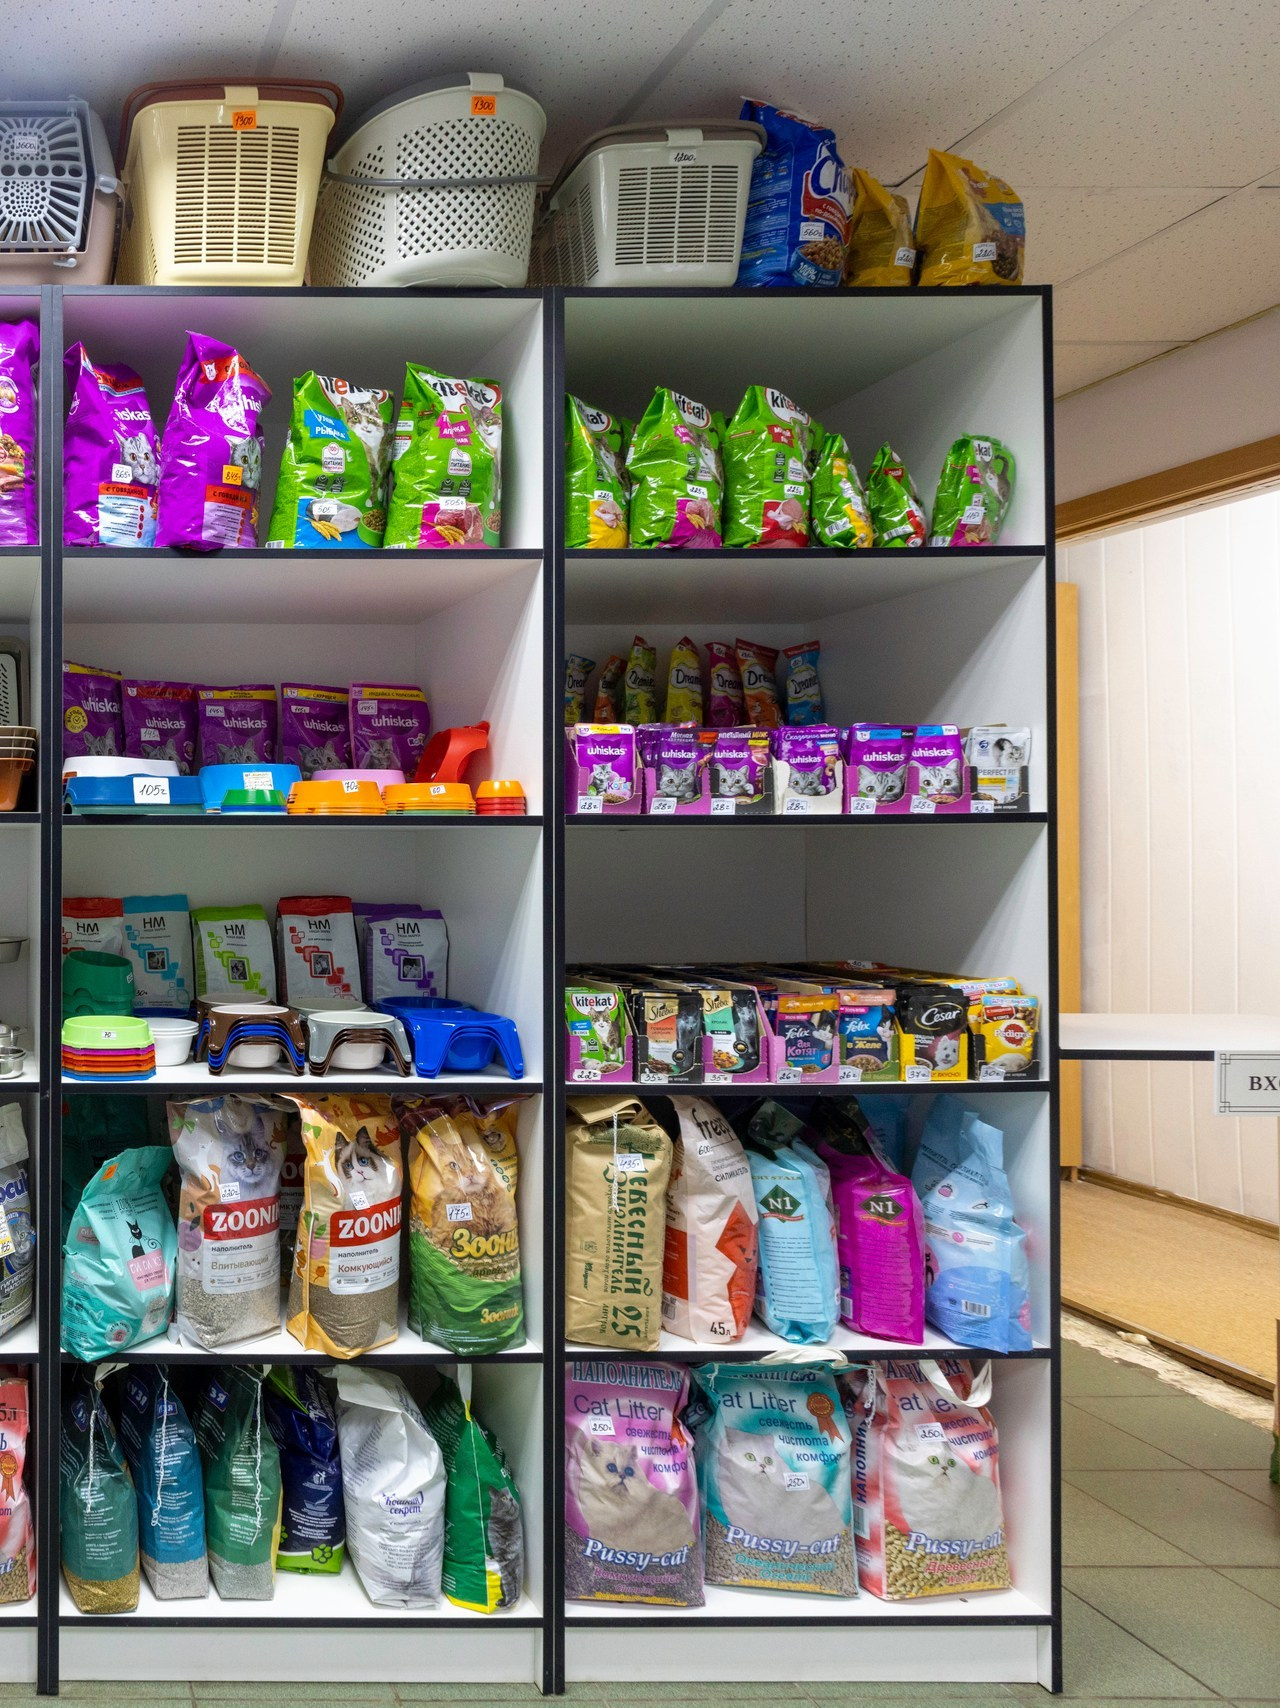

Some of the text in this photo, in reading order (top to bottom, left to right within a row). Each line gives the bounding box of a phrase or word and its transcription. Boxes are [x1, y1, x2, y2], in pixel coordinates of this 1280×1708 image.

[146, 717, 186, 729] whiskas
[223, 718, 268, 729] whiskas
[303, 719, 346, 732] whiskas
[371, 715, 419, 728] whiskas
[587, 746, 625, 755] whiskas
[661, 750, 698, 759] whiskas
[714, 750, 749, 759] whiskas
[863, 752, 905, 762] whiskas
[911, 747, 954, 757] whiskas
[790, 754, 821, 764] whiskas
[977, 768, 1007, 776] PERFECT
[575, 996, 613, 1008] kitekat
[705, 995, 729, 1012] Sheba
[649, 1003, 675, 1021] Sheba
[920, 1007, 960, 1026] Cesar
[784, 1028, 811, 1041] felix
[845, 1021, 870, 1035] felix
[1249, 1075, 1280, 1092] ВХ
[714, 1167, 749, 1183] СИЛИКАГЕЛЬ
[768, 1196, 795, 1210] N1
[869, 1200, 896, 1215] N1
[211, 1243, 254, 1253] наполнитель
[337, 1248, 379, 1259] наполнитель
[211, 1256, 269, 1271] Впитывающий
[337, 1256, 393, 1274] Комкующийся
[572, 1363, 682, 1392] НАПОЛНИТЕЛЬ
[574, 1394, 665, 1421] Cat Litter
[751, 1391, 797, 1413] Litter
[759, 1417, 813, 1431] свежесть
[778, 1434, 829, 1447] чистота
[726, 1524, 841, 1558] Pussy-cat
[905, 1529, 1003, 1557] Pussy-cat
[584, 1537, 690, 1572] Pussy-cat
[924, 1557, 995, 1573] Древесный
